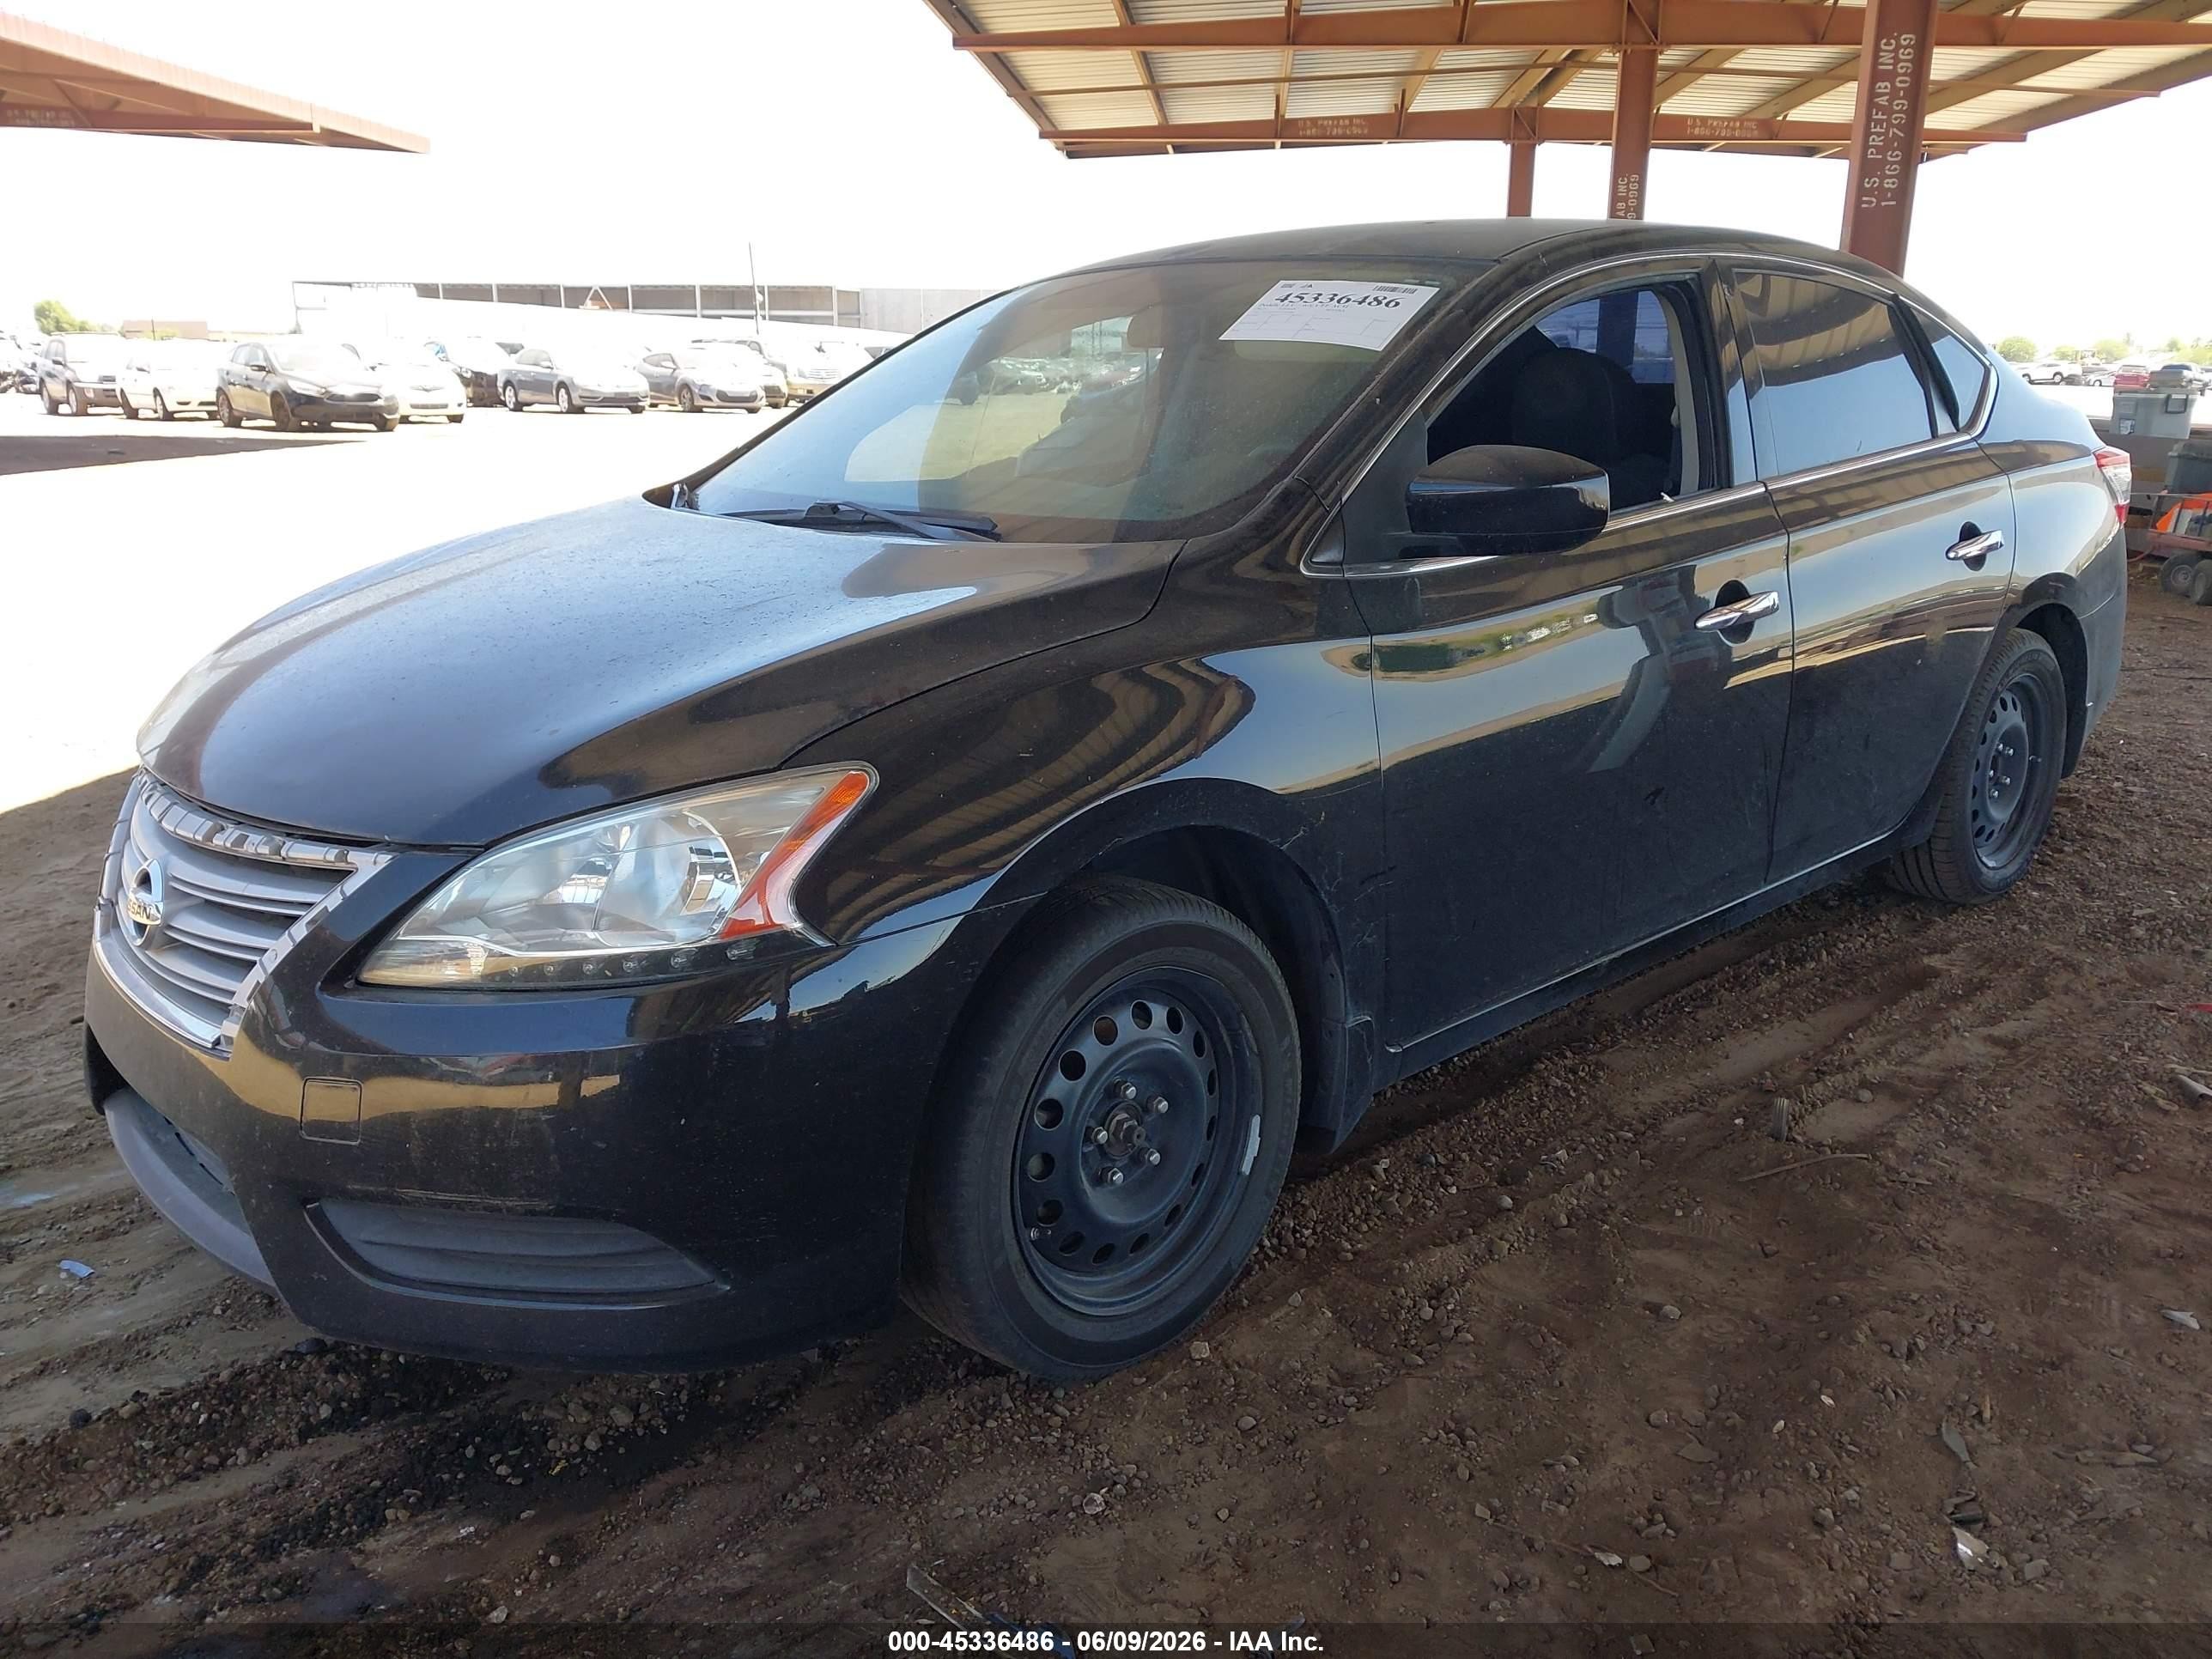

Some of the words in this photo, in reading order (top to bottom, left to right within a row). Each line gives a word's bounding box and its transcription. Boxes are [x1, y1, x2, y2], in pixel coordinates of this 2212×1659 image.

[1878, 32, 1898, 70] INC.
[1868, 82, 1891, 159] PREFAB
[1881, 33, 1916, 206] 1-866-799-0969
[1617, 173, 1629, 196] INC.
[1862, 171, 1881, 208] U.S.
[1274, 292, 1407, 308] 45336486
